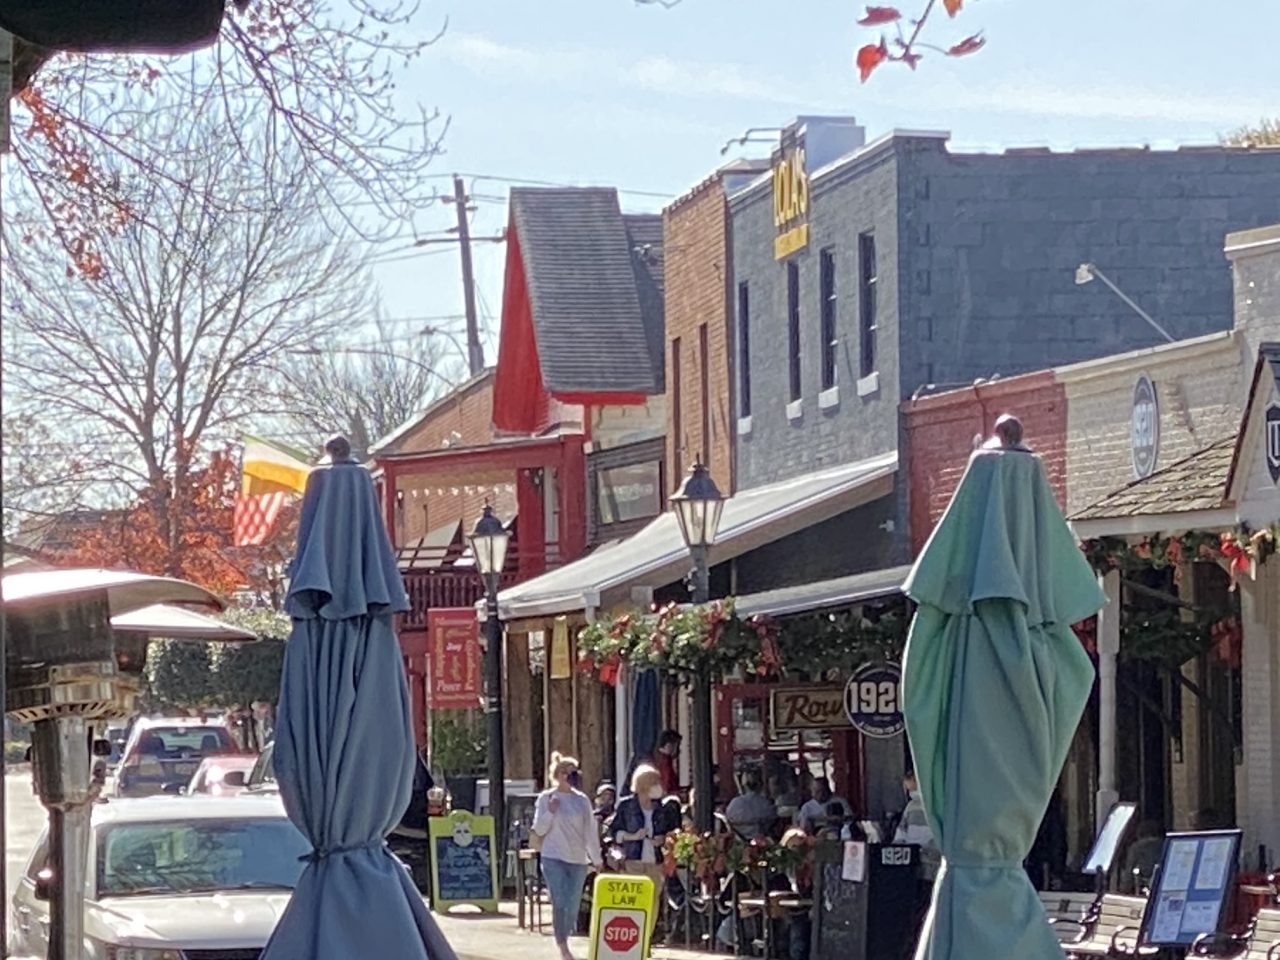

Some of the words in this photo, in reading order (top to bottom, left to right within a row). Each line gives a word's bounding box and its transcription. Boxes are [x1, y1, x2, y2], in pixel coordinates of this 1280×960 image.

[882, 847, 911, 865] 1920
[608, 881, 643, 894] STATE
[612, 894, 637, 905] LAW
[605, 927, 638, 941] STOP
